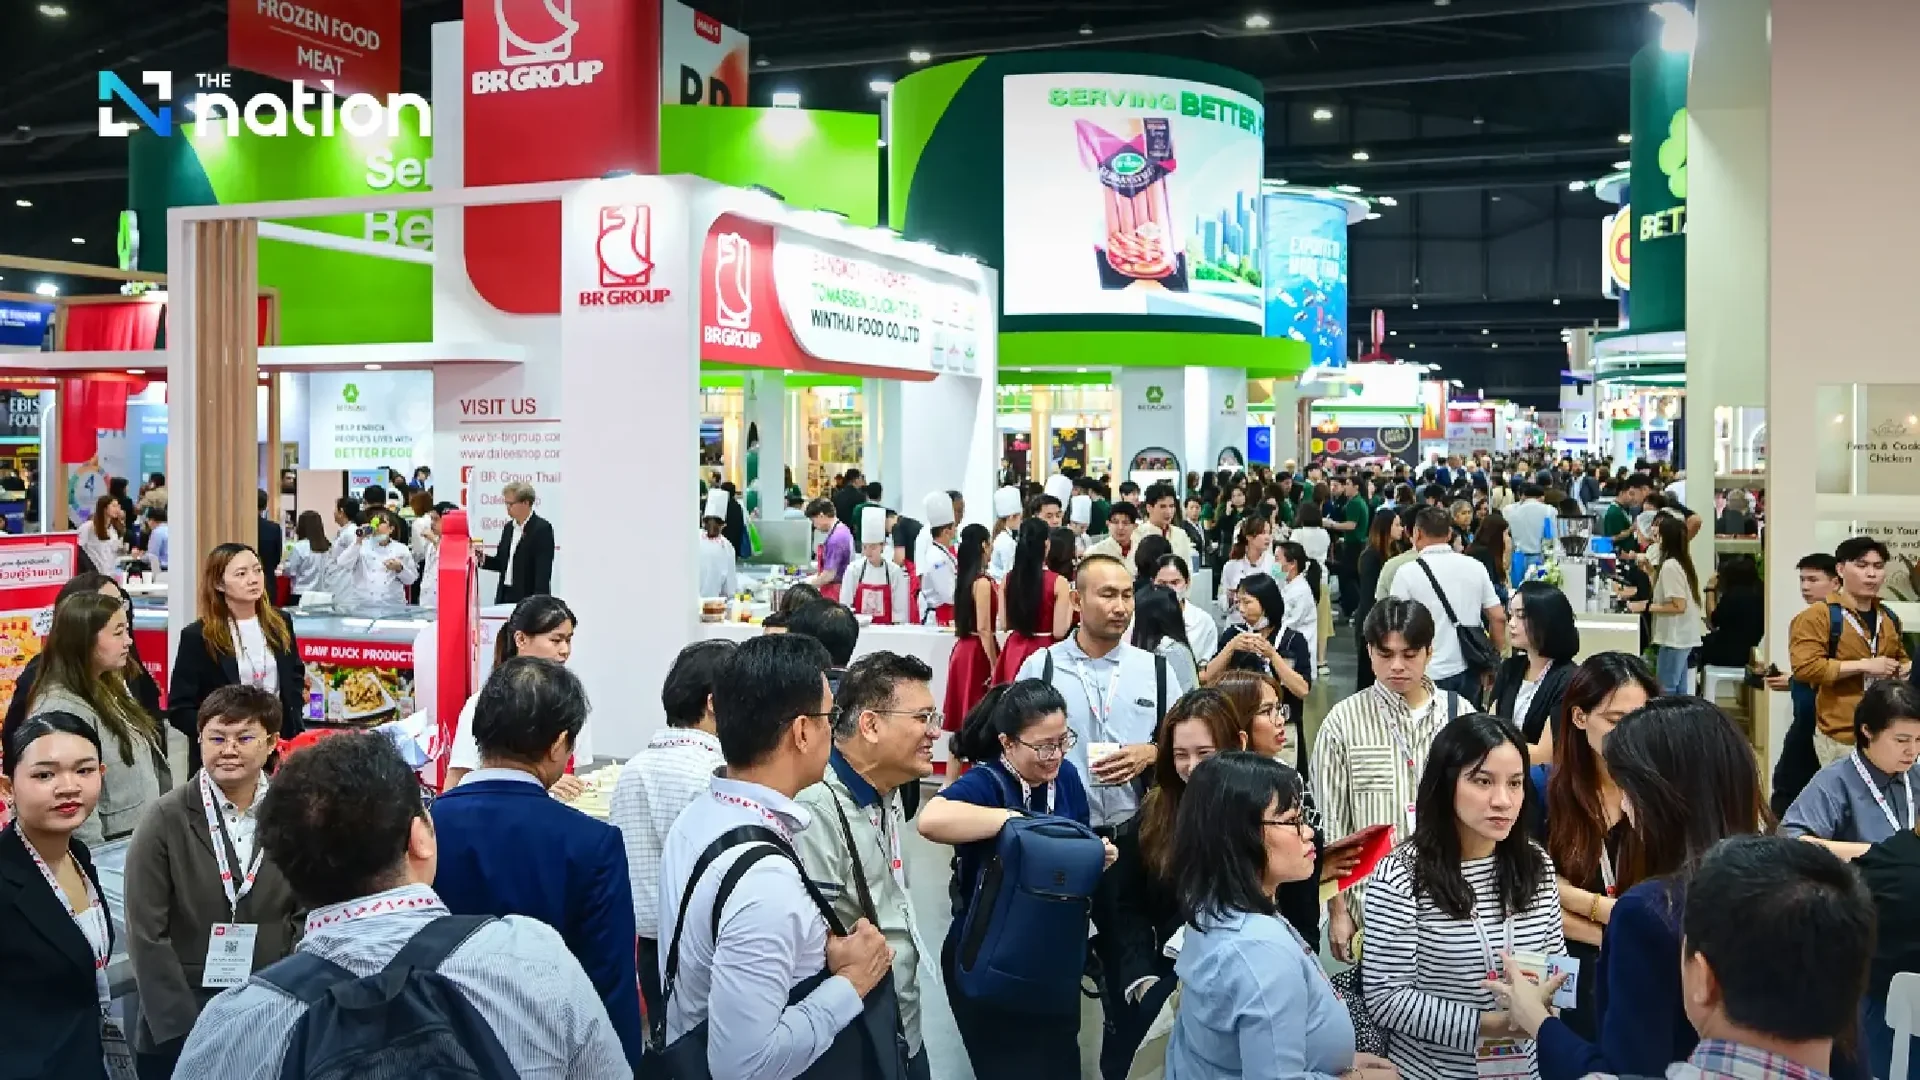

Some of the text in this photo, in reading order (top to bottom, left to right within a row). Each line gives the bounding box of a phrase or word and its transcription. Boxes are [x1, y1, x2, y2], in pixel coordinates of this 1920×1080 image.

[257, 0, 380, 51] FROZEN FOOD
[297, 45, 344, 76] MEAT
[472, 60, 604, 94] BR GROUP
[1180, 91, 1256, 133] BETTER
[580, 289, 671, 306] BR GROUP
[811, 309, 855, 333] WINTHAI
[857, 316, 884, 337] FOOD
[704, 325, 763, 349] BR GROUP
[460, 399, 537, 415] VISIT US
[335, 447, 412, 458] BETTER FOOD
[1869, 453, 1912, 463] Chicken
[480, 472, 496, 483] BR
[500, 471, 532, 484] Group
[1884, 526, 1893, 534] to
[1897, 525, 1919, 535] Your
[304, 645, 328, 656] RAW
[331, 647, 360, 659] DUCK
